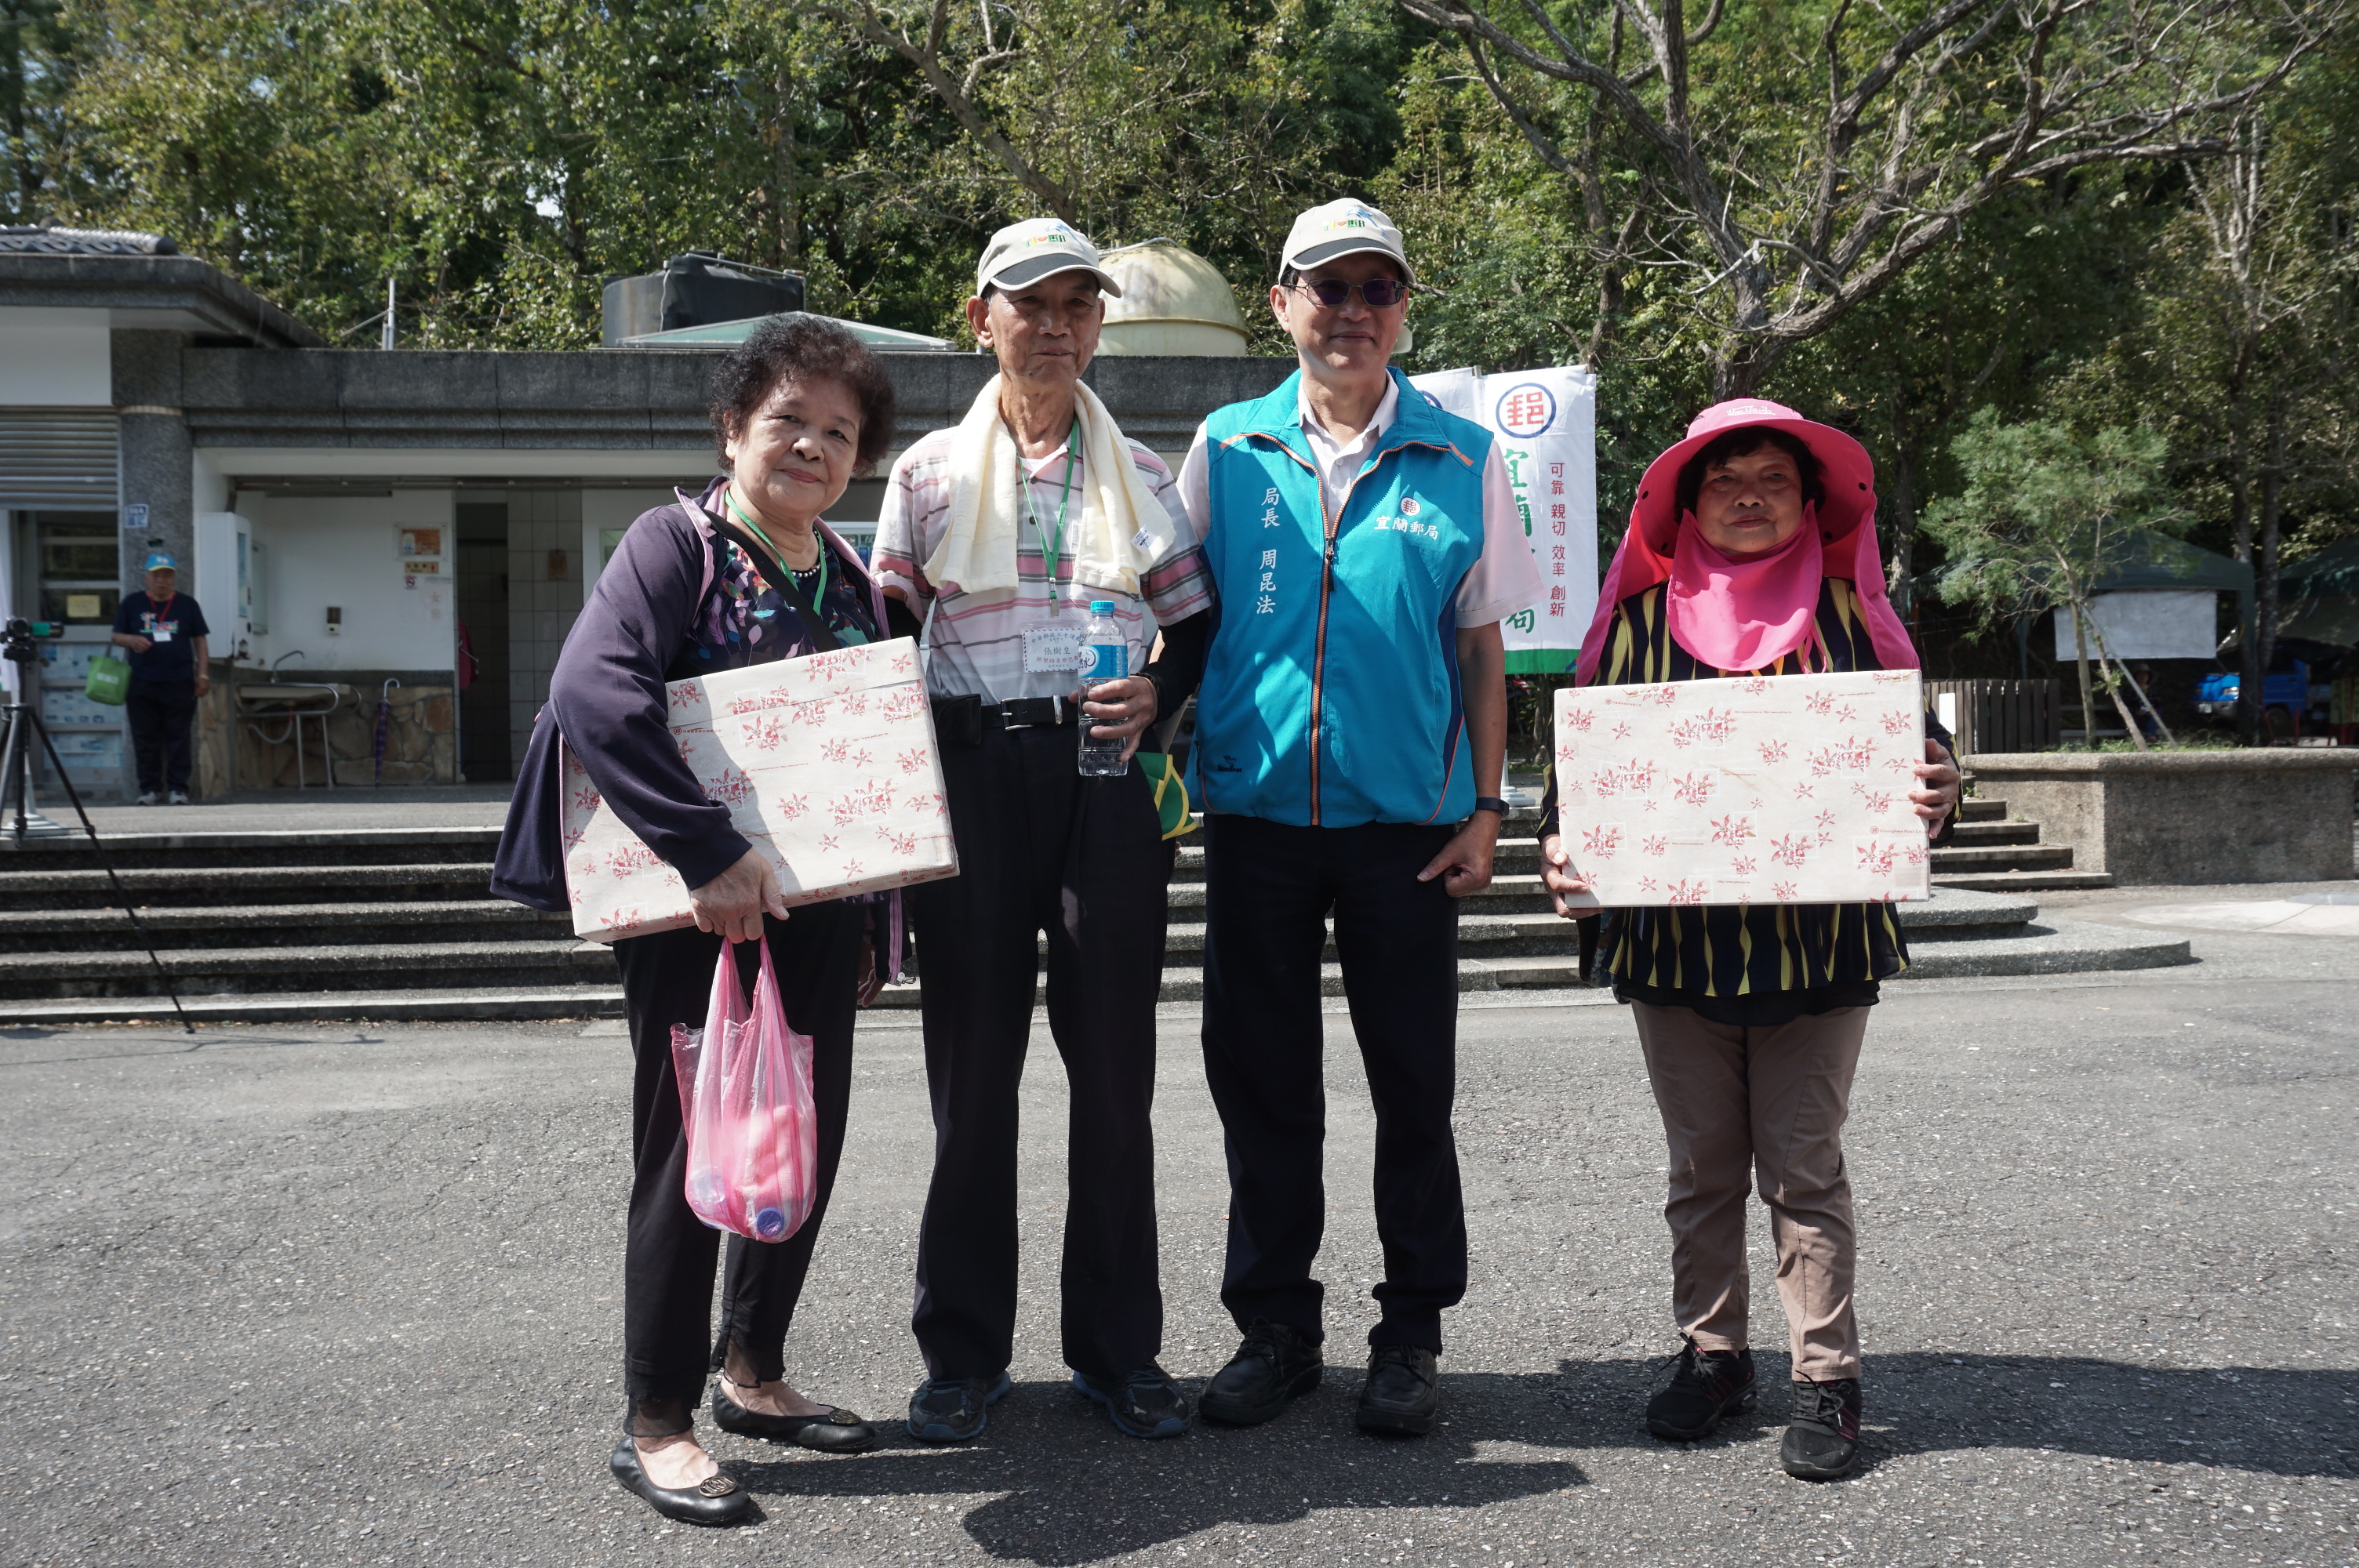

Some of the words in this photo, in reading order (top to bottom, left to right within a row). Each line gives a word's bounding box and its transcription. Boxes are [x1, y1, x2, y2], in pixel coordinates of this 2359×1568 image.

[1506, 391, 1544, 427] 郵
[1549, 462, 1565, 496] 可靠
[1261, 487, 1281, 528] 局長
[1402, 499, 1417, 514] 郵
[1550, 503, 1566, 536] 親切
[1373, 515, 1439, 540] 宜蘭郵局
[1551, 543, 1566, 578] 效率
[1256, 549, 1278, 615] 周昆法
[1549, 584, 1566, 618] 創新
